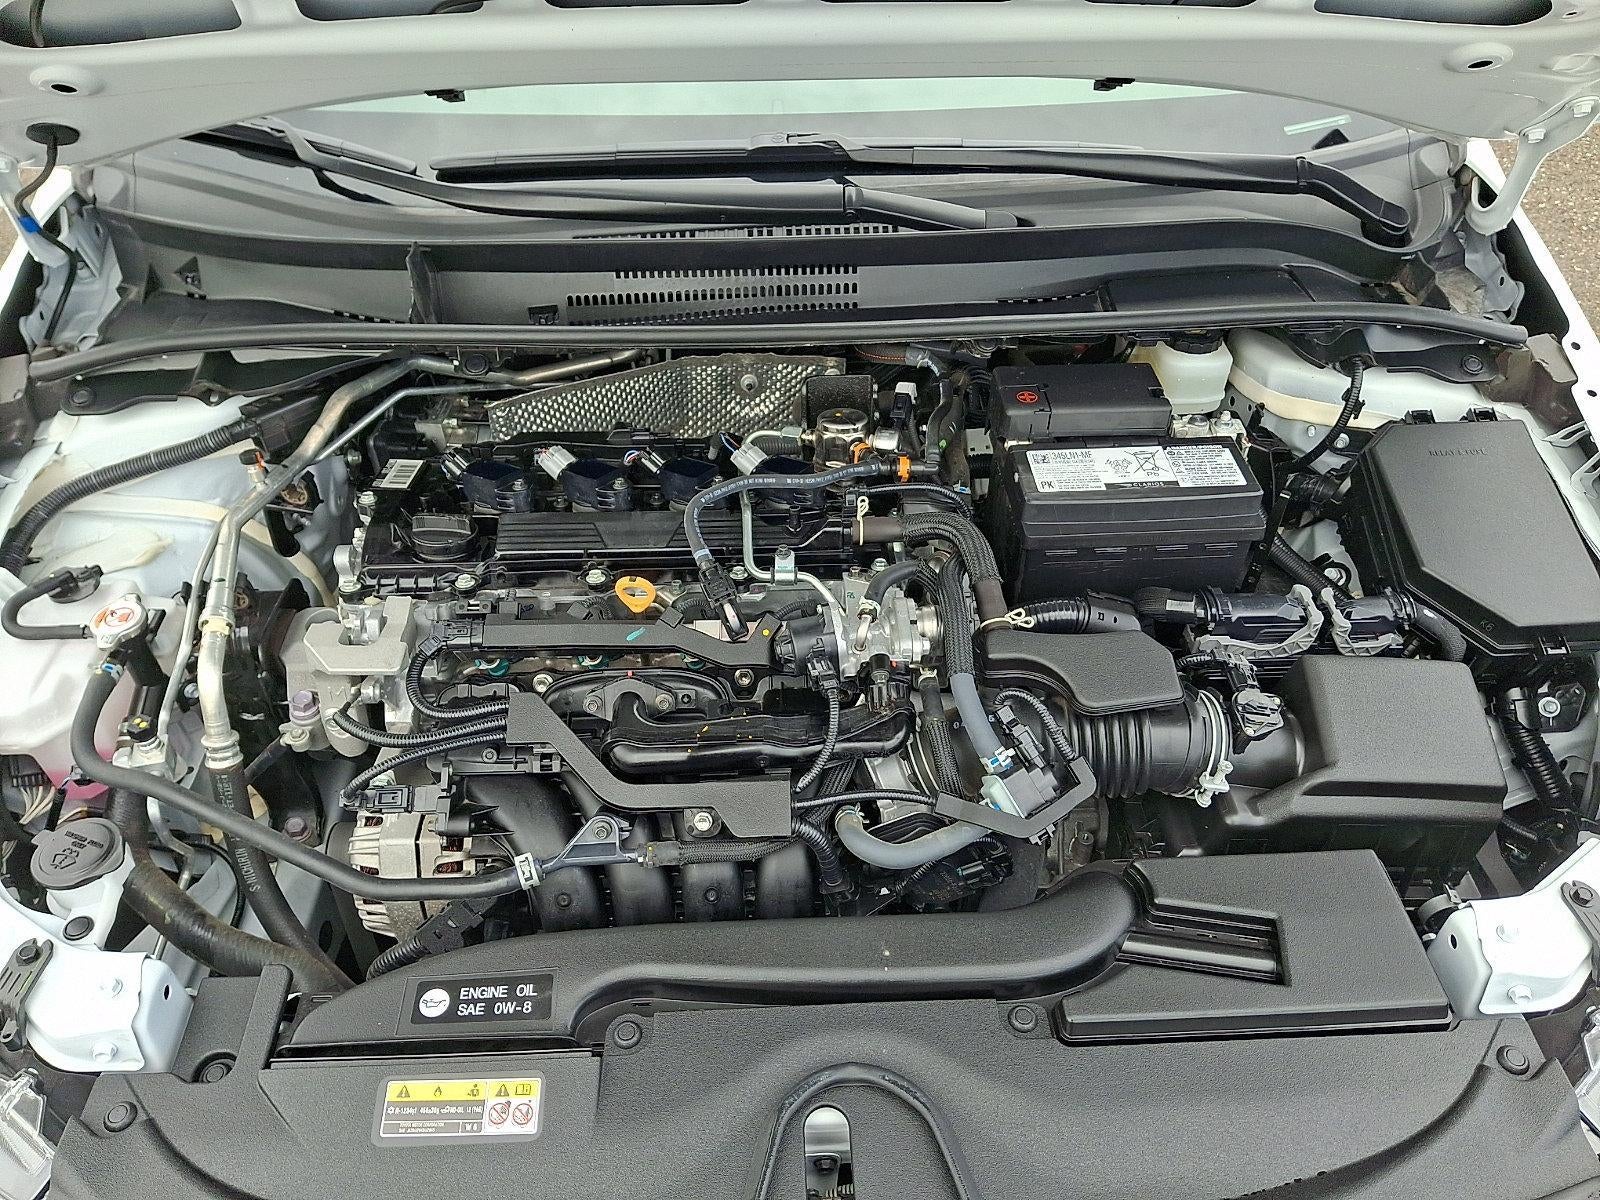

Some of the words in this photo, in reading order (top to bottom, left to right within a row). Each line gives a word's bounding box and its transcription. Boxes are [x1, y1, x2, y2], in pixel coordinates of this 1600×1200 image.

[1040, 481, 1055, 490] PK
[459, 985, 508, 1000] ENGINE
[516, 984, 538, 997] OIL
[457, 1002, 486, 1016] SAE
[493, 1001, 532, 1015] 0W-8
